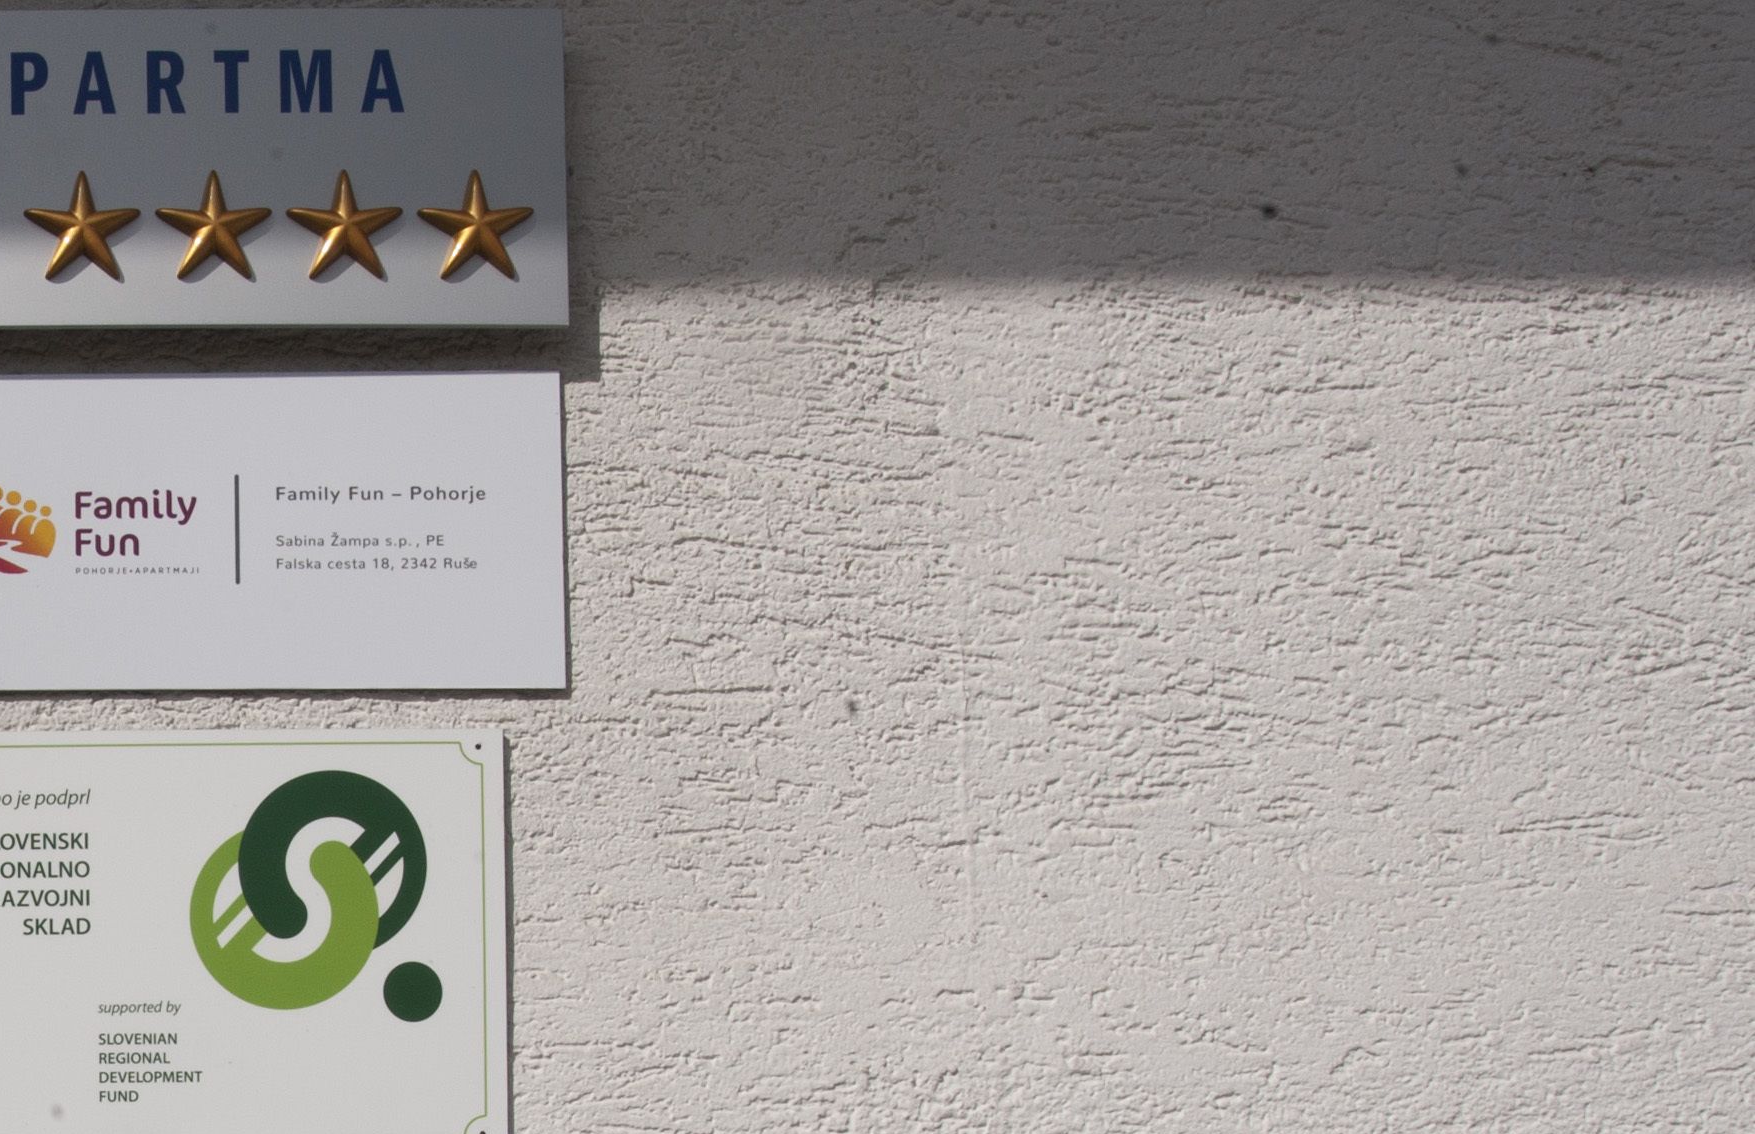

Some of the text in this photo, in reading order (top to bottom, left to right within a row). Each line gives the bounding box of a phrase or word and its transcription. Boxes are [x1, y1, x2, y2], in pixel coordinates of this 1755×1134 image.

[275, 486, 341, 505] Family
[348, 486, 384, 501] Fun
[410, 485, 486, 505] Pohorje
[74, 488, 197, 526] Family
[75, 528, 140, 557] Fun
[275, 534, 325, 548] Sabina
[330, 531, 380, 549] Žampa
[426, 534, 444, 547] PE
[276, 557, 478, 571] Falska cesta 18, 2342 Ruše
[14, 791, 30, 809] je
[34, 788, 91, 810] podprl
[22, 917, 91, 936] SKLAD
[98, 1000, 182, 1017] supported by
[98, 1032, 178, 1046] SLOVENIAN
[98, 1051, 171, 1065] REGIONAL
[98, 1070, 203, 1084] DEVELOPMENT
[99, 1090, 139, 1103] FUND
